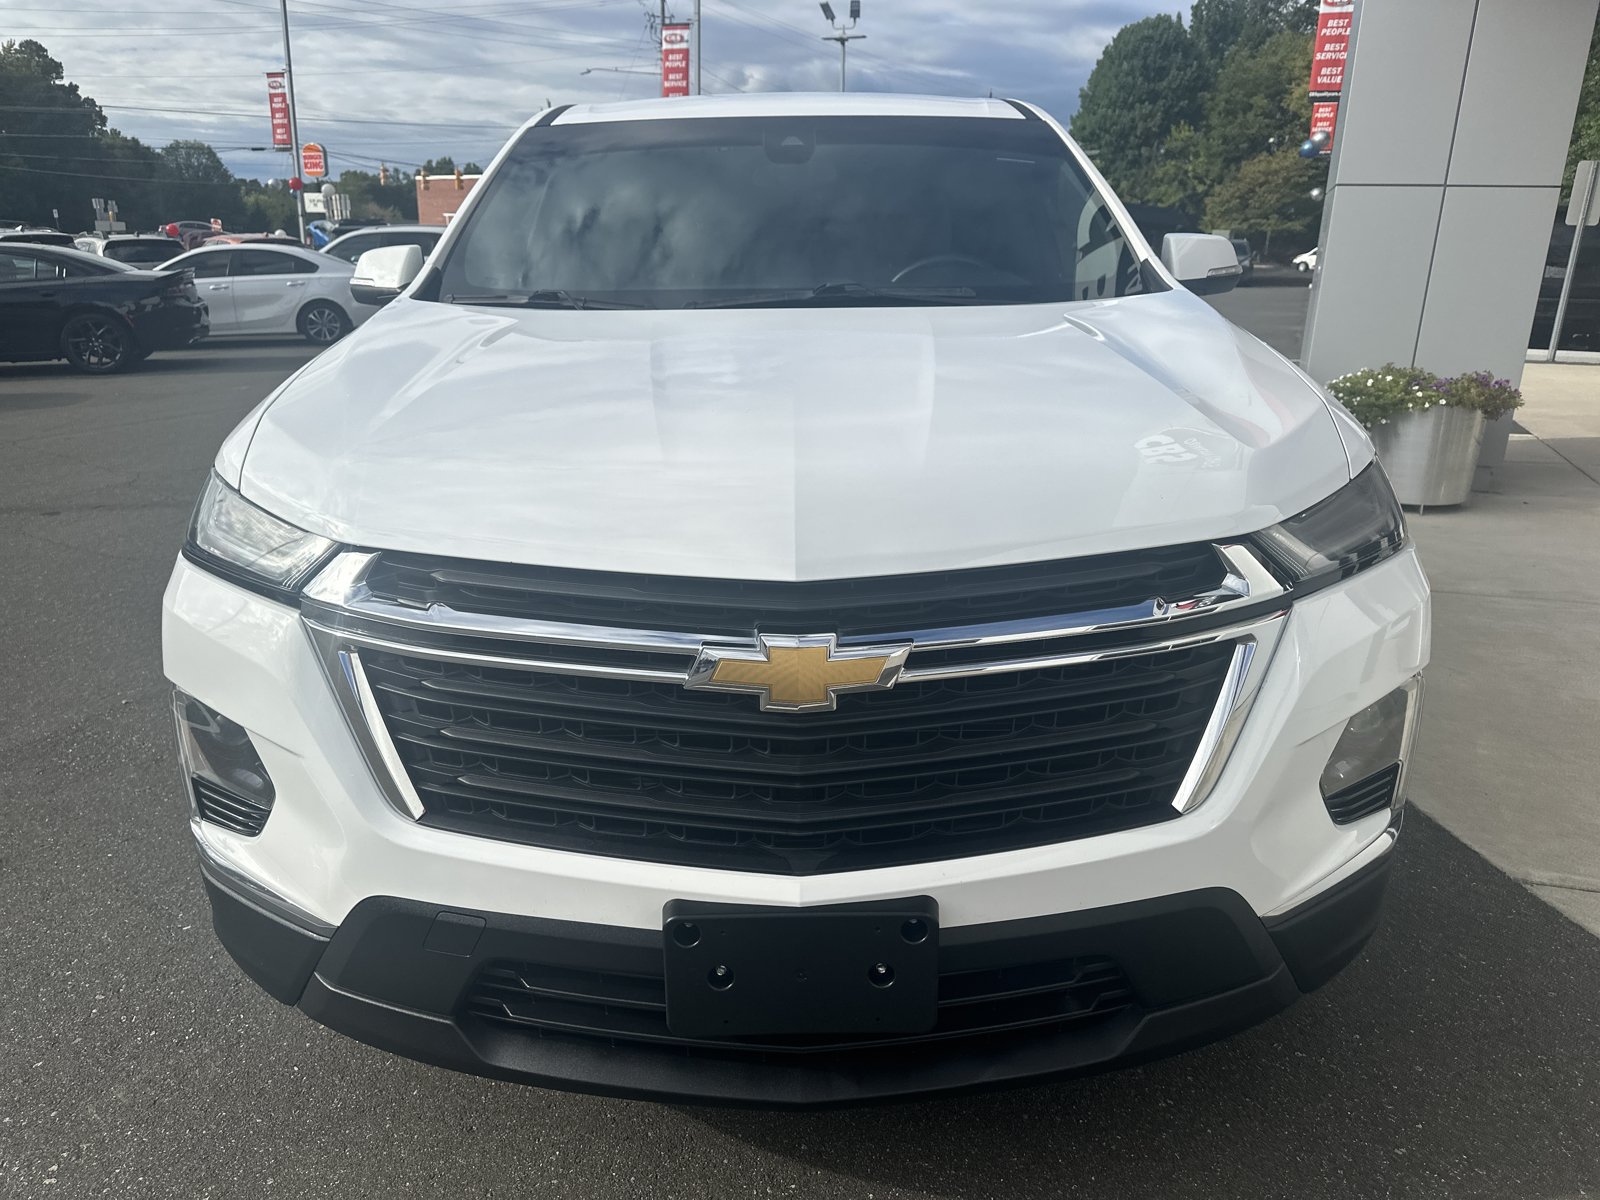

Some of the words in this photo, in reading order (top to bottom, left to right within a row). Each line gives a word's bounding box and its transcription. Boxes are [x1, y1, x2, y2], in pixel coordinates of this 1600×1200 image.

[1327, 19, 1349, 27] BEST
[1320, 27, 1351, 36] PEOPLE
[1324, 43, 1346, 51] BEST
[1320, 67, 1342, 75] BEST
[1317, 75, 1343, 84] VALUE
[304, 160, 324, 170] KING
